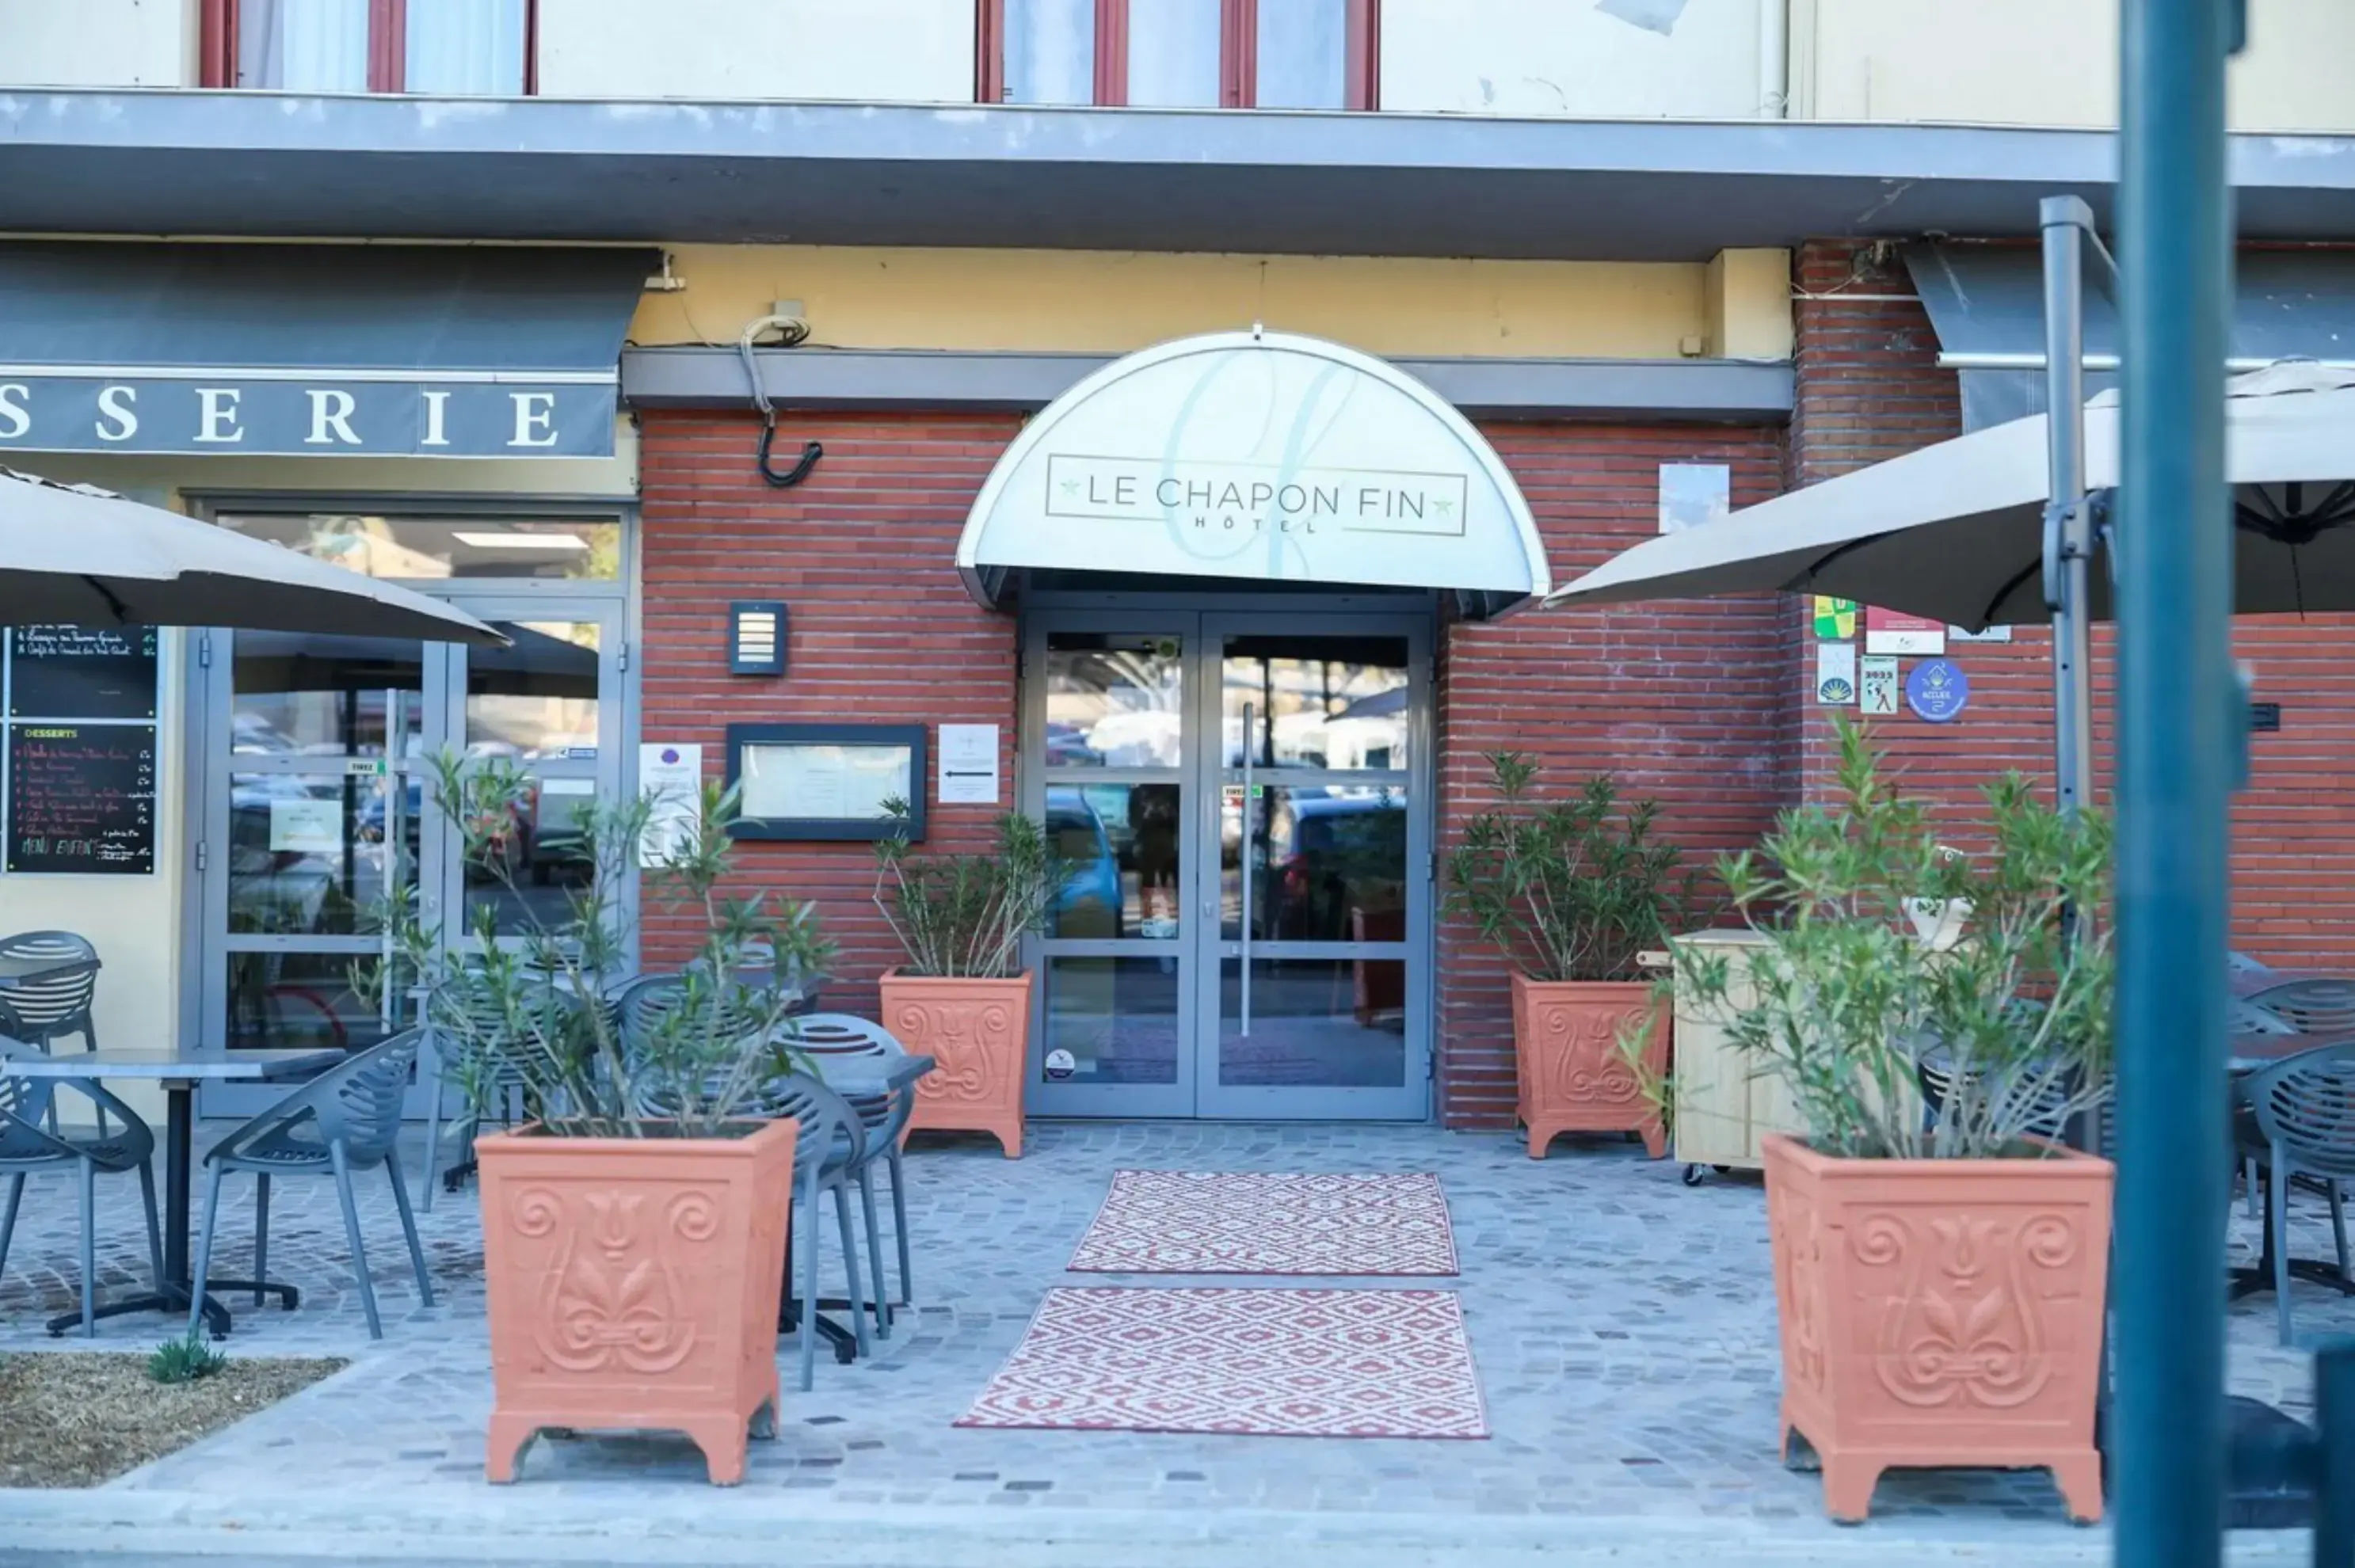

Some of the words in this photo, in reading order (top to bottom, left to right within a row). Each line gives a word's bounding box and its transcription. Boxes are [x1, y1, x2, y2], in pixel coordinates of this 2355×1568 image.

[1088, 475, 1137, 505] LE
[1156, 478, 1339, 515] CHAPON
[1359, 488, 1424, 519] FIN
[1195, 516, 1316, 534] HÔTEL
[25, 729, 78, 738] DESSERTS
